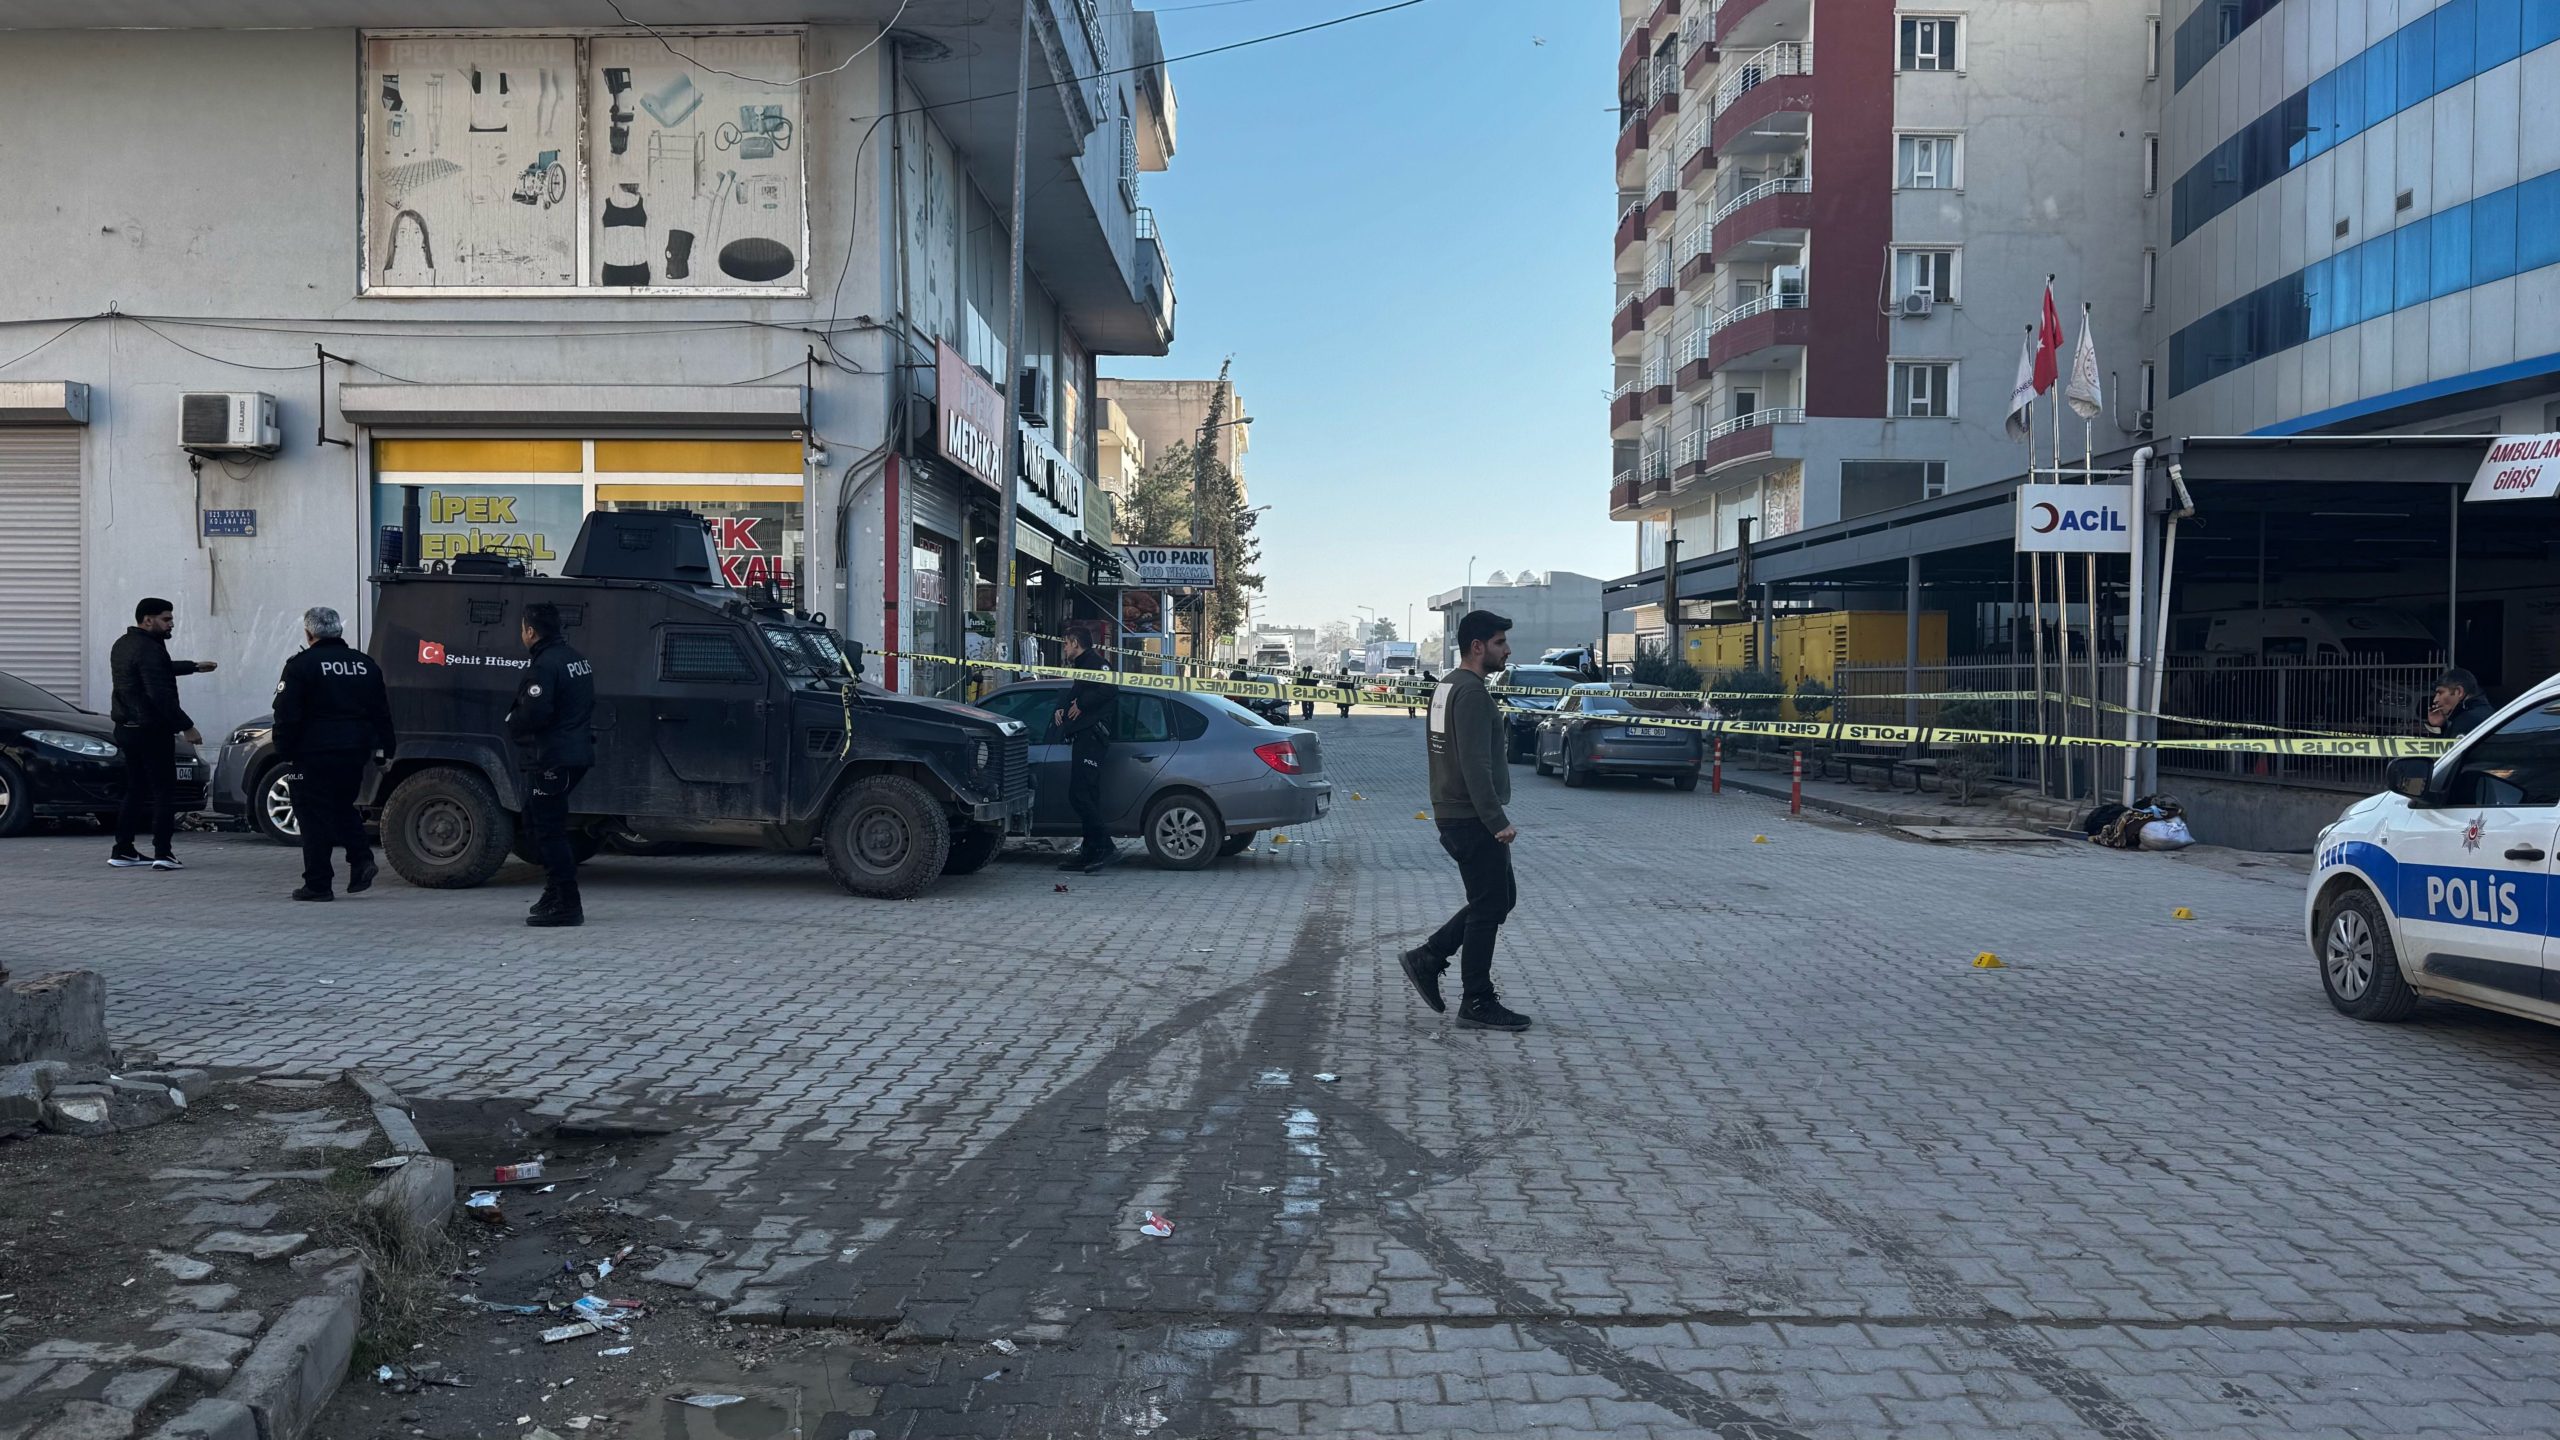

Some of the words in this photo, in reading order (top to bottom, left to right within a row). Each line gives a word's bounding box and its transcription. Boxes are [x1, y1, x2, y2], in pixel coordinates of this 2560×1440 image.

[2493, 465, 2544, 493] GİRİŞİ
[430, 490, 517, 523] İPEK
[2059, 505, 2127, 531] ACİL
[420, 528, 556, 560] EDİKAL
[703, 516, 762, 551] EK
[1138, 550, 1167, 564] OTO
[1171, 551, 1209, 565] PARK
[1140, 566, 1164, 578] OTO
[969, 618, 986, 626] fuse
[445, 653, 481, 666] Şehit
[2427, 874, 2519, 925] POLİS
